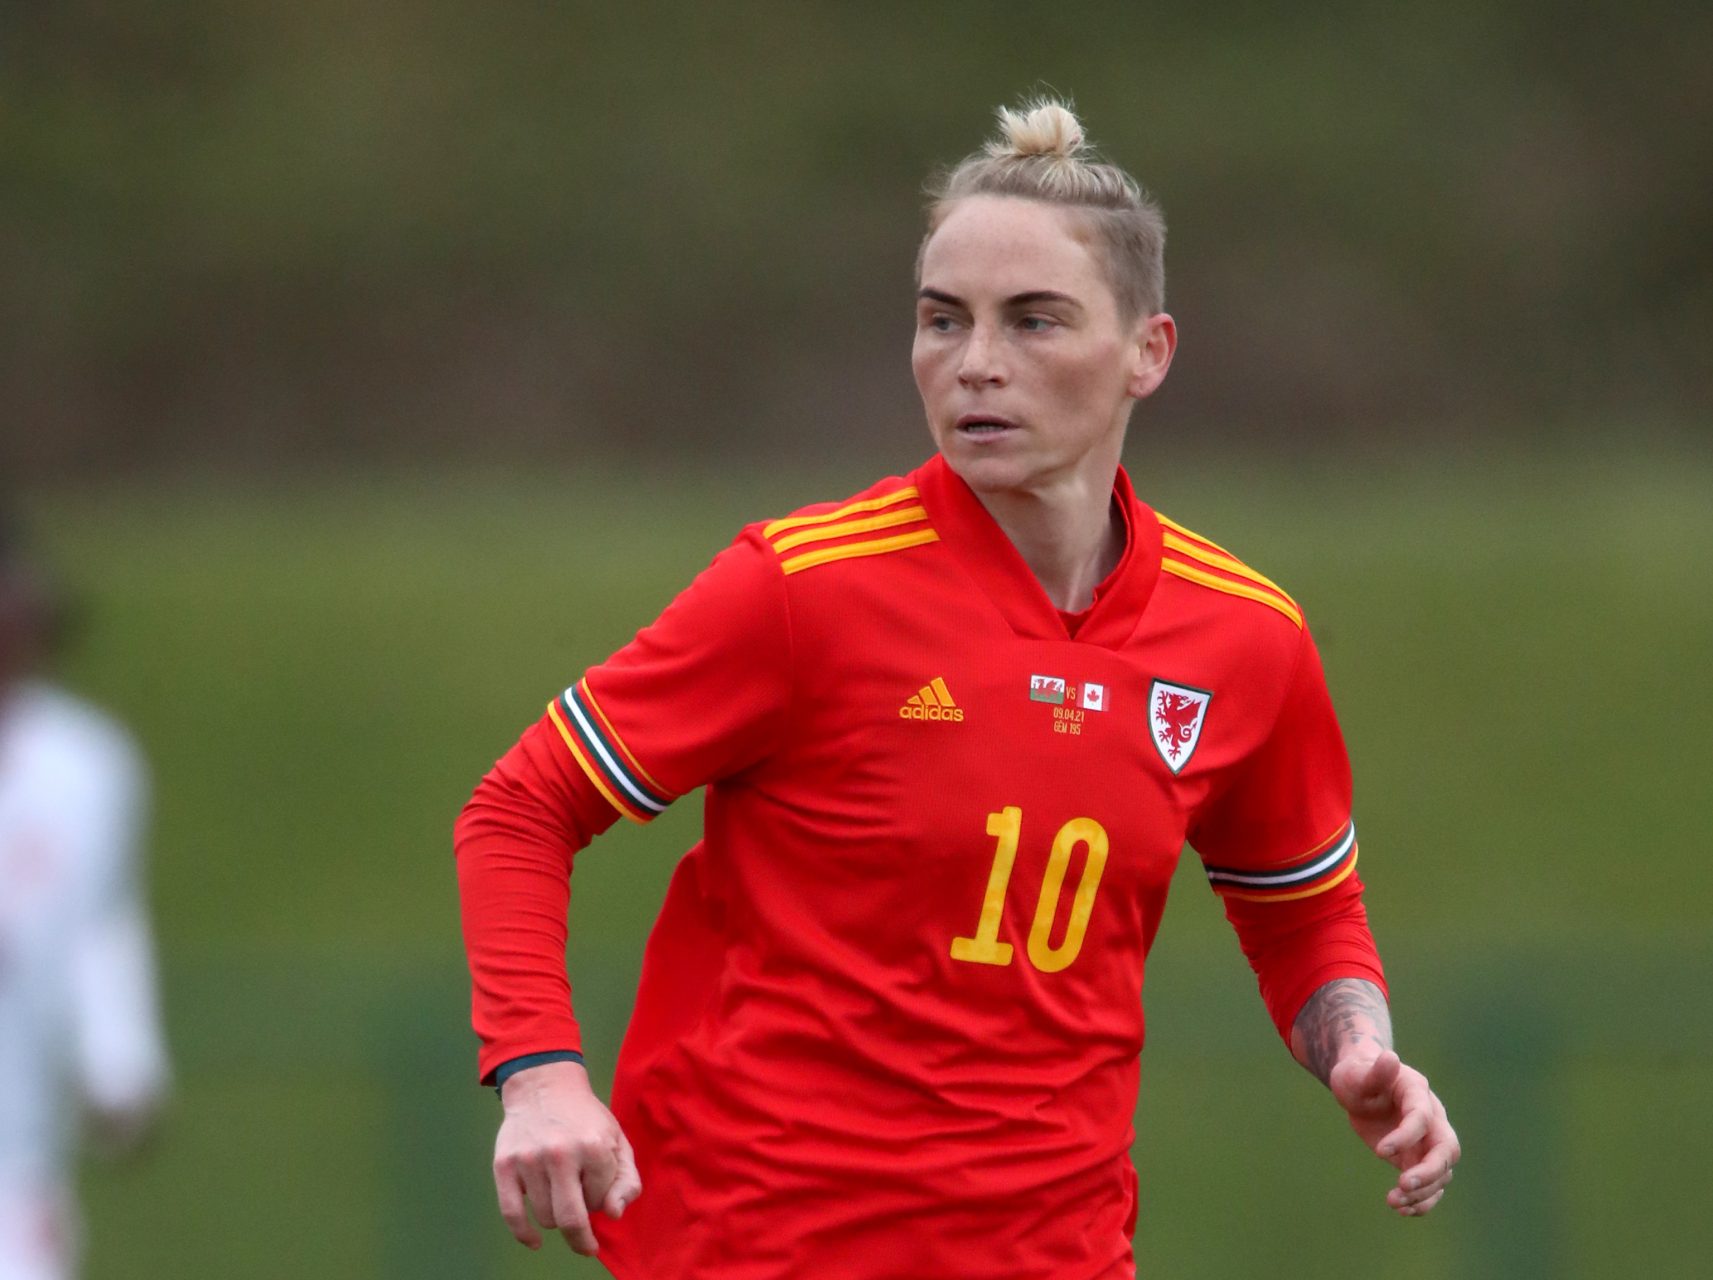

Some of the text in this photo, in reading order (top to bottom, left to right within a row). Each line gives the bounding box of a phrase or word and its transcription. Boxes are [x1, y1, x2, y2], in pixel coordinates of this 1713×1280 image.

[1065, 685, 1076, 700] VS
[899, 703, 964, 722] adidas
[1053, 706, 1085, 723] 09.04.21
[950, 806, 1109, 973] 10
